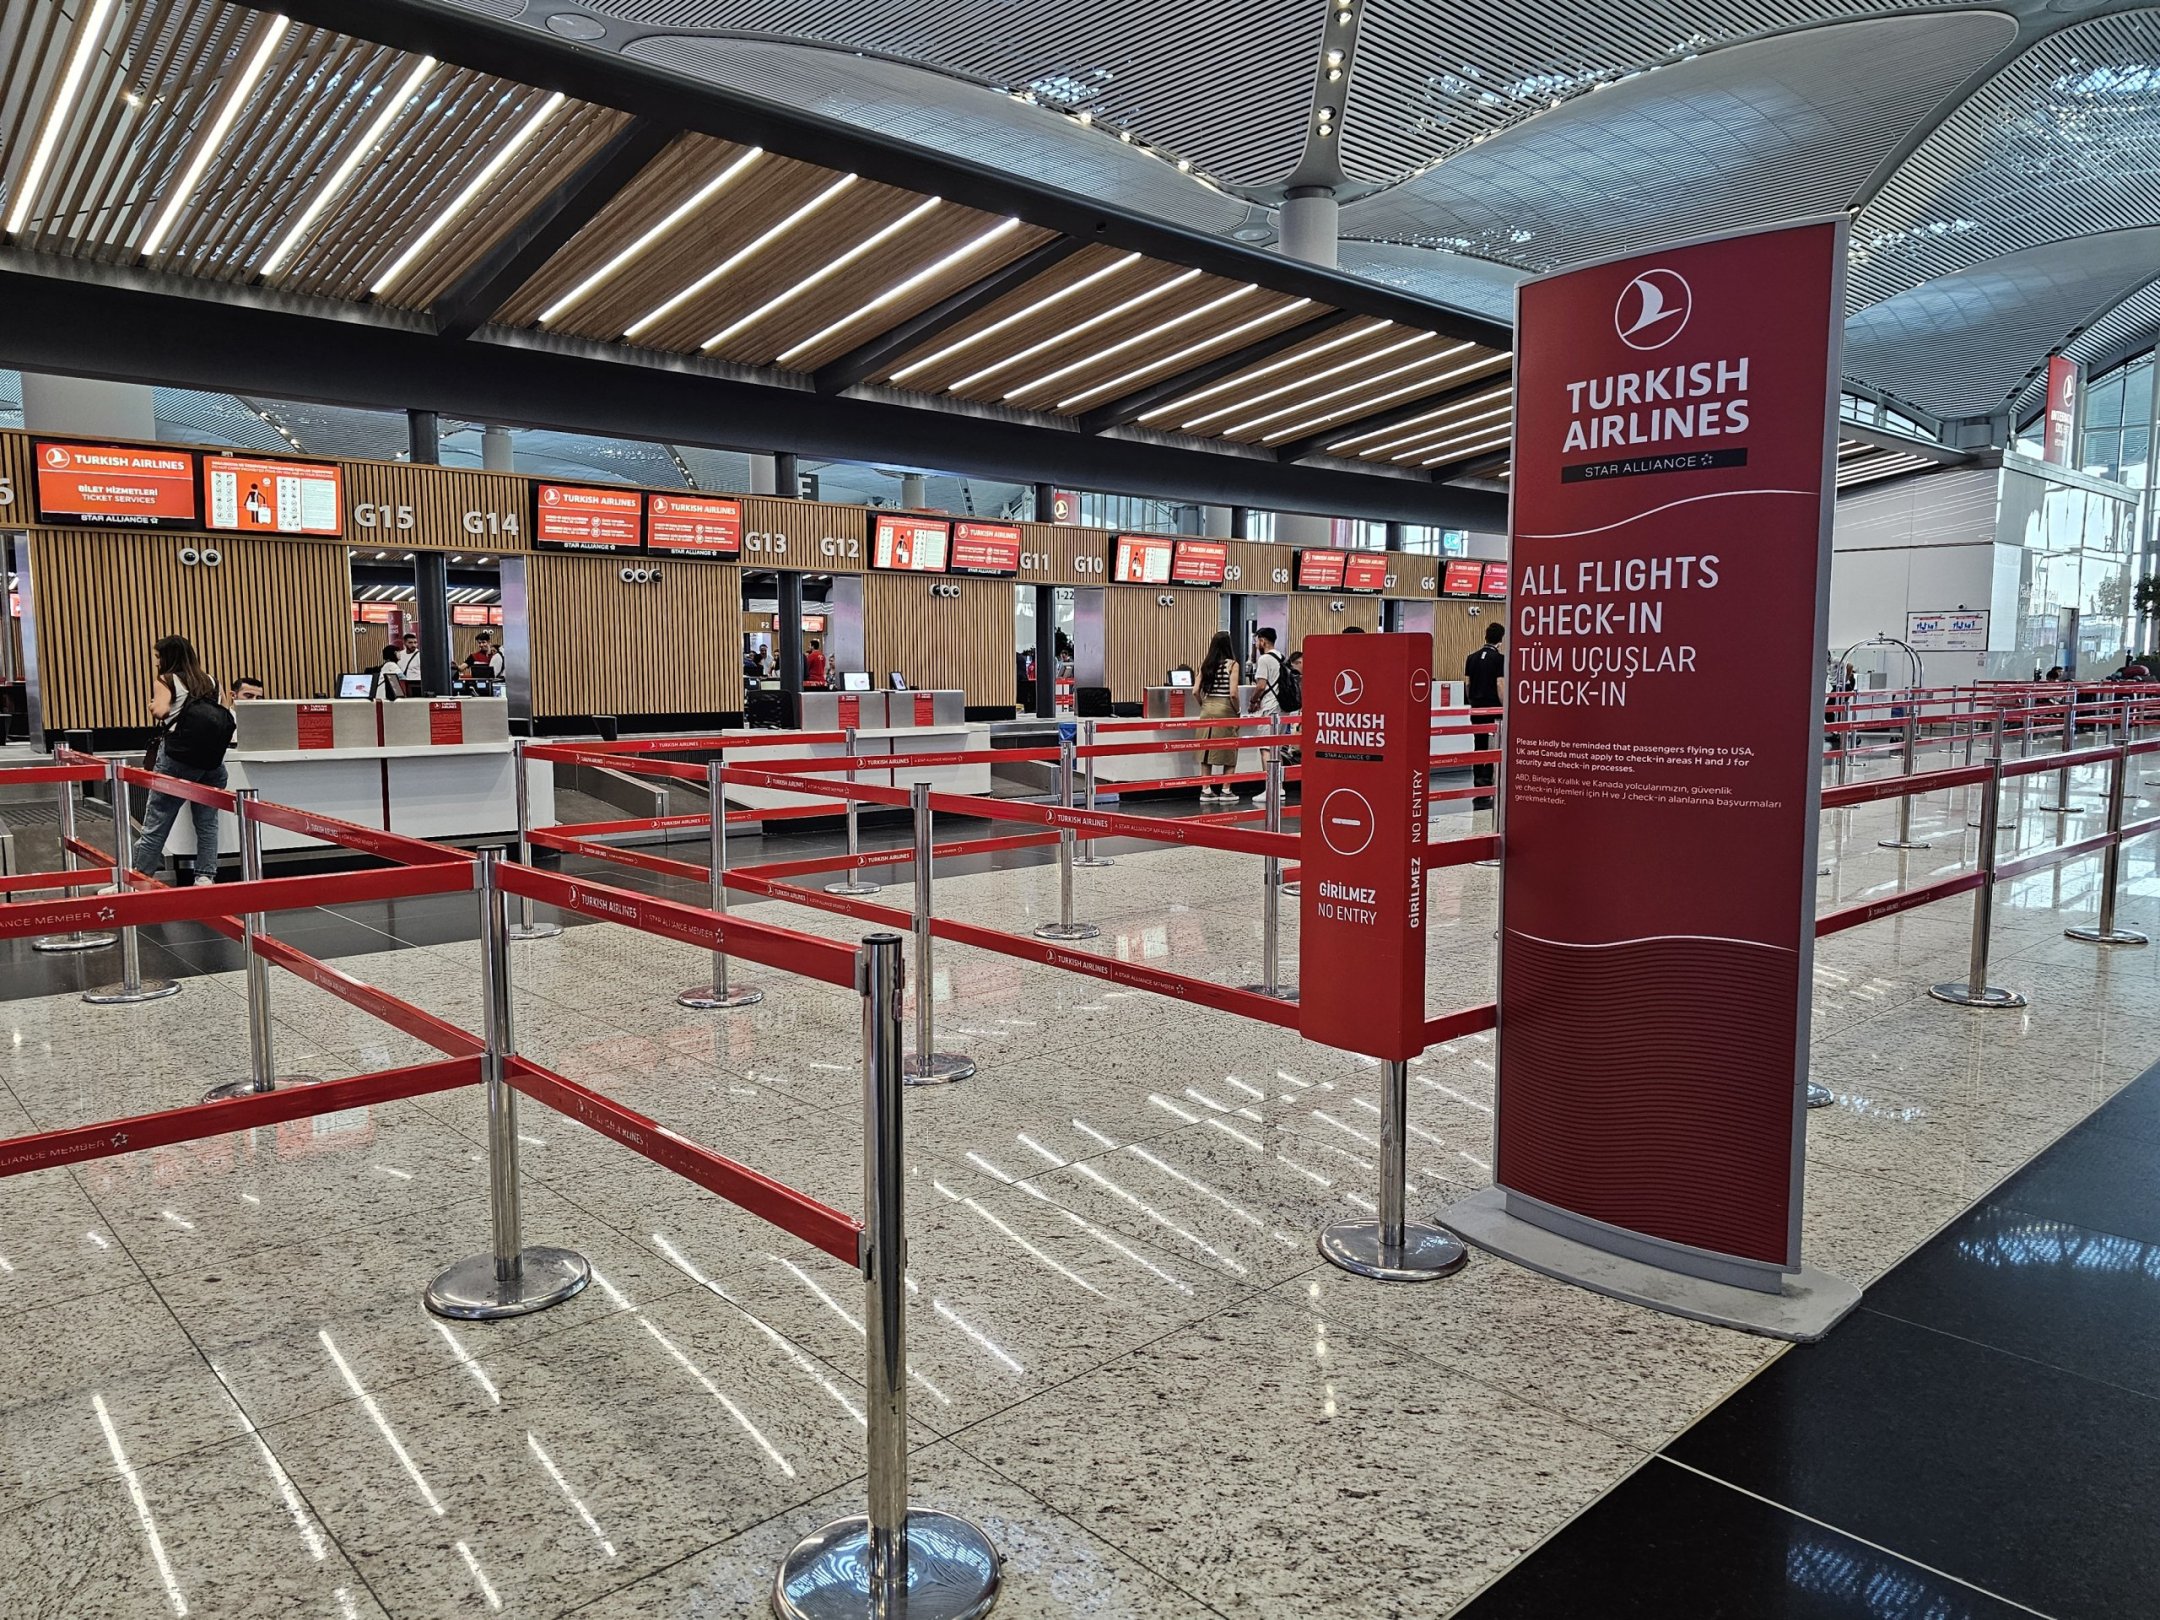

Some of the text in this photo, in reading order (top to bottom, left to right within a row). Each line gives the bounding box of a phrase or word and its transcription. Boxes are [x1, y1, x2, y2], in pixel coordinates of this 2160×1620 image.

[1566, 357, 1748, 414] TURKISH
[1562, 399, 1749, 453] AIRLINES
[74, 454, 185, 470] TURKISH AIRLINES
[1584, 455, 1697, 479] STAR ALLIANCE
[78, 485, 158, 496] BİLET HİZMETLERİ
[82, 493, 156, 504] TICKET SERVICES
[563, 493, 636, 507] TURKISH AIRLINES
[354, 503, 414, 529] G15
[670, 503, 736, 515] TURKISH AIRLINES
[81, 514, 149, 524] STAR ALLIANCE
[463, 511, 519, 536] G14
[745, 531, 787, 554] G13
[969, 528, 1018, 539] TURKISH AIRLINES
[820, 537, 859, 558] G12
[1020, 552, 1048, 571] G11
[1074, 556, 1104, 574] G10
[1224, 565, 1242, 581] G9
[1272, 568, 1289, 583] G8
[1384, 574, 1397, 588] G7
[1520, 564, 1567, 596] ALL
[1578, 555, 1720, 593] FLIGHTS
[1421, 576, 1436, 590] G6
[761, 621, 770, 629] F2
[1520, 601, 1663, 636] CHECK-IN
[1519, 641, 1697, 679] TÜM UÇUŞLAR
[1518, 679, 1626, 707] CHECK-IN
[1316, 712, 1385, 730] TURKISH
[1315, 729, 1386, 748] AIRLINES
[1516, 737, 1537, 746] Please
[1538, 739, 1559, 749] kindly
[1572, 742, 1610, 750] reminded
[1612, 743, 1631, 751] that
[1633, 745, 1685, 755] passengers
[1687, 745, 1714, 756] flying
[1717, 747, 1728, 755] to
[1730, 747, 1755, 757] USA,
[1338, 753, 1364, 761] ALLIANCE
[1515, 758, 1635, 773] security and check-in processes.
[1516, 747, 1749, 767] UK and Canada must apply to check-in areas H and J for
[1515, 773, 1531, 782] ABD,
[1532, 774, 1556, 784] Birleşik
[1557, 777, 1580, 786] Krallık
[1592, 780, 1623, 789] Kanada
[1625, 783, 1689, 794] yolcularımızın,
[1691, 785, 1733, 795] güvenlik
[1514, 793, 1567, 806] gerekmektedir.
[1523, 784, 1552, 793] check-in
[1553, 787, 1585, 797] işlemleri
[1586, 790, 1600, 799] için
[1622, 792, 1626, 800] J
[1627, 793, 1667, 803] check-in
[1668, 796, 1714, 805] alanlarına
[1716, 797, 1782, 809] başvurmaları
[1057, 814, 1108, 828] TURKISH AIRLINES
[1409, 769, 1423, 929] GİRİLMEZ NO ENTRY
[1319, 879, 1376, 905] GİRİLMEZ
[581, 893, 637, 919] TURKISH AIRLINES
[1318, 902, 1377, 926] NO ENTRY
[35, 912, 92, 926] MEMBER
[1058, 955, 1108, 974] TURKISH AIRLINES
[50, 1140, 105, 1157] MEMBER
